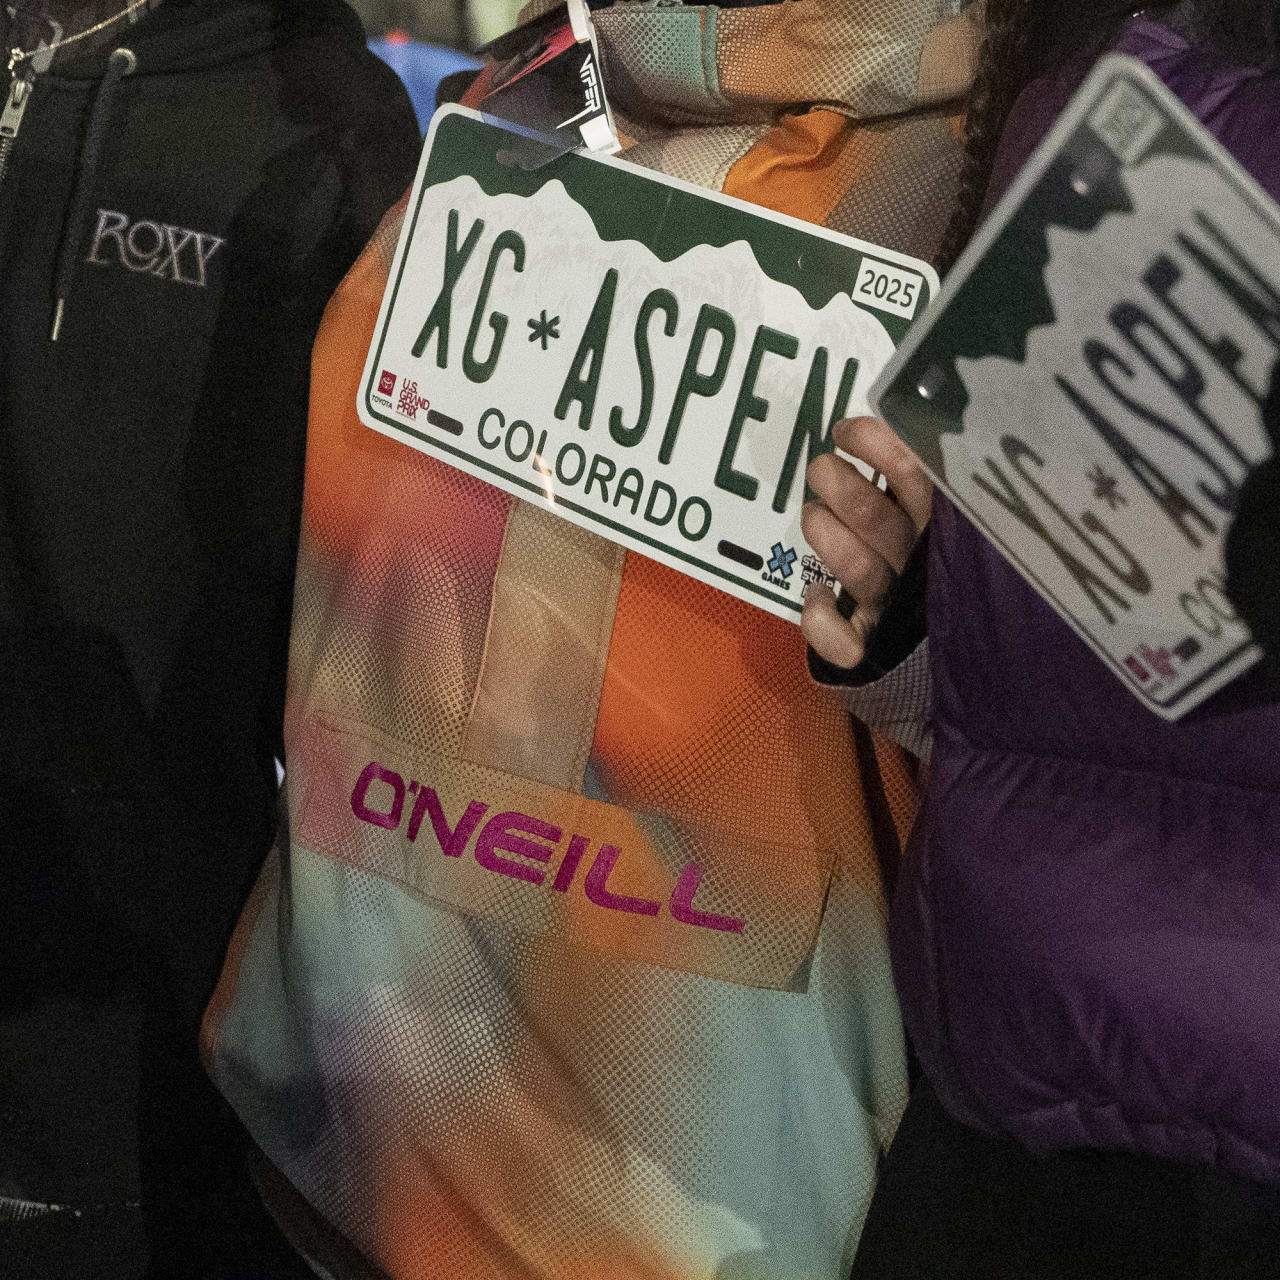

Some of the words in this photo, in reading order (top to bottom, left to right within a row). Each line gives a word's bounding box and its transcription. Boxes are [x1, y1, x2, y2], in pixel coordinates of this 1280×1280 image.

[556, 53, 602, 129] VIPER
[87, 208, 227, 287] ROXY
[859, 268, 915, 308] 2025
[371, 394, 393, 410] TOYOTA
[396, 400, 419, 418] PRIX
[399, 389, 430, 411] GRAND
[477, 406, 713, 542] COLORADO
[761, 572, 792, 591] GAMES
[350, 761, 747, 934] O'NEILL
